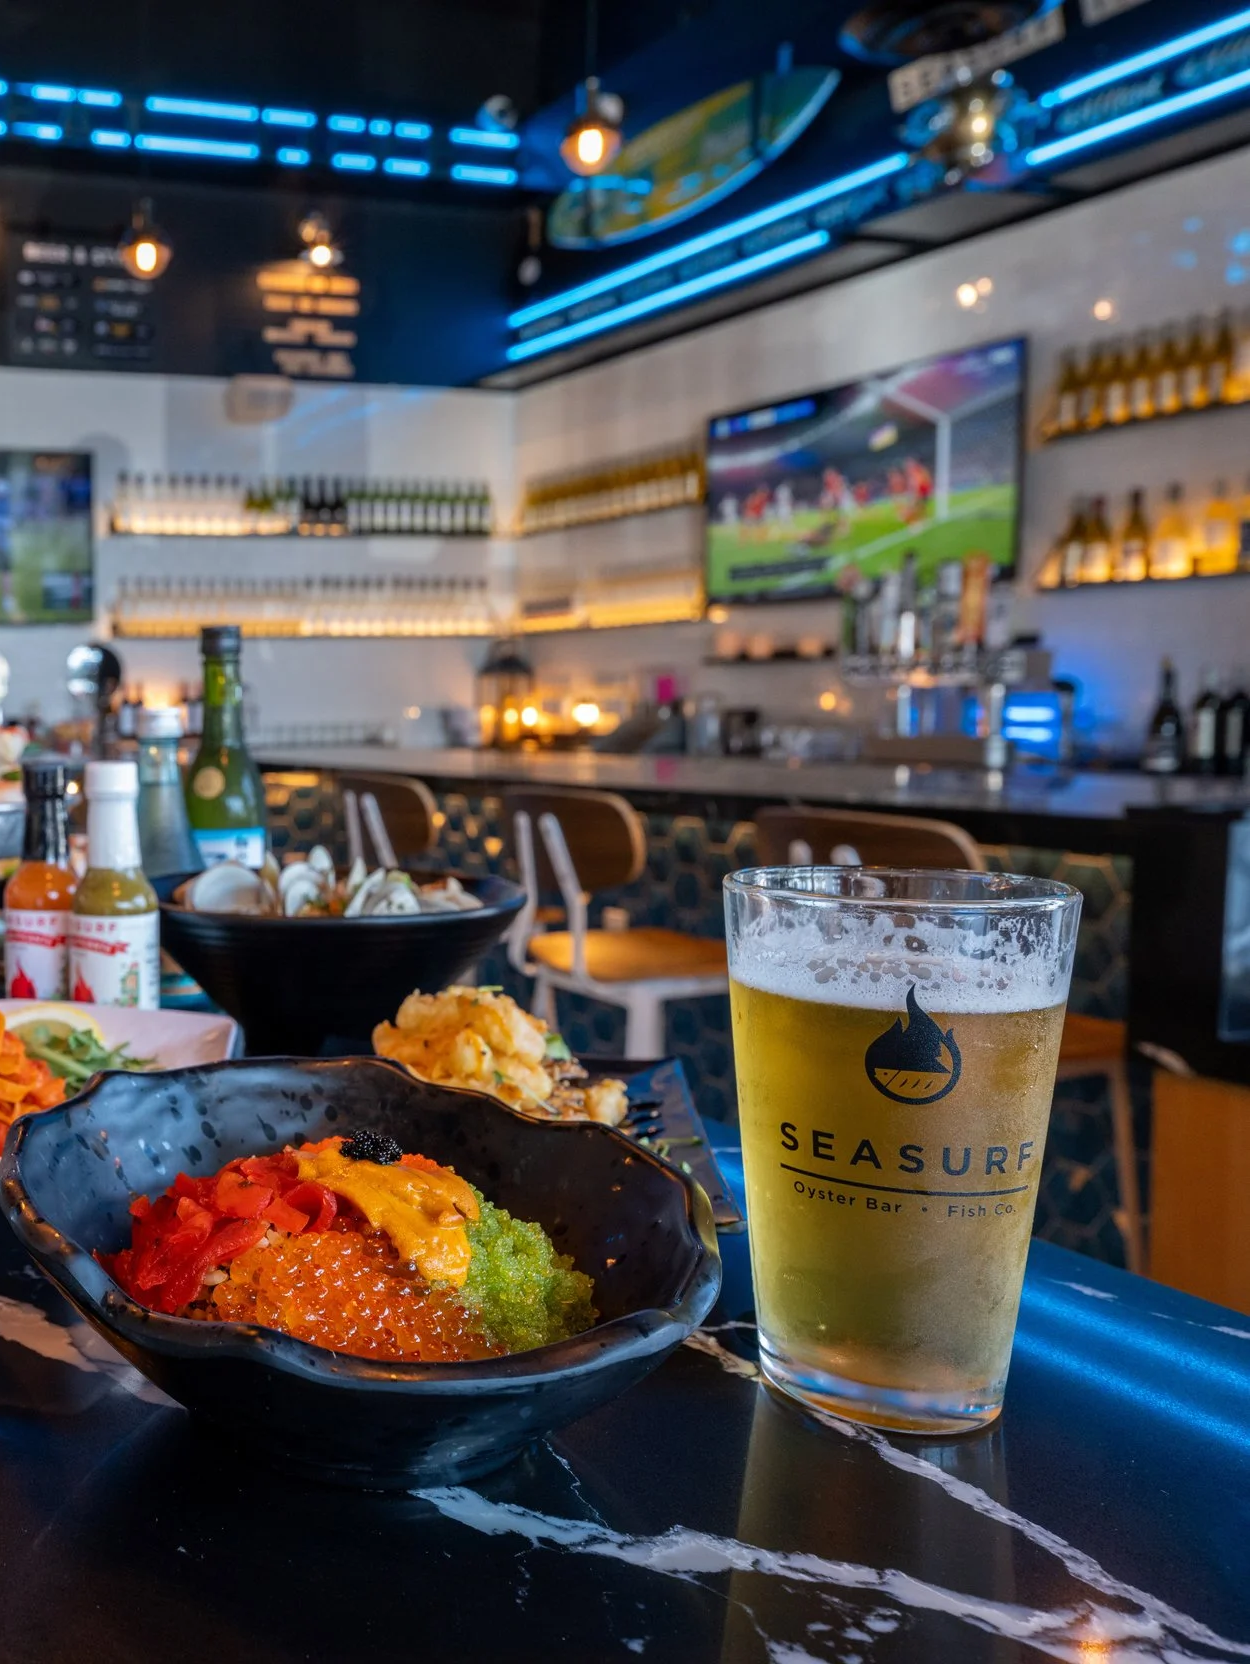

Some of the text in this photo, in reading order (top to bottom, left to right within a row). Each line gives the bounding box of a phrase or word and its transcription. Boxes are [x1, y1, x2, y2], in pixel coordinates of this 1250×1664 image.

[780, 1121, 1034, 1176] SEASURF
[793, 1180, 1017, 1218] Oyster Bar Fish Co.
